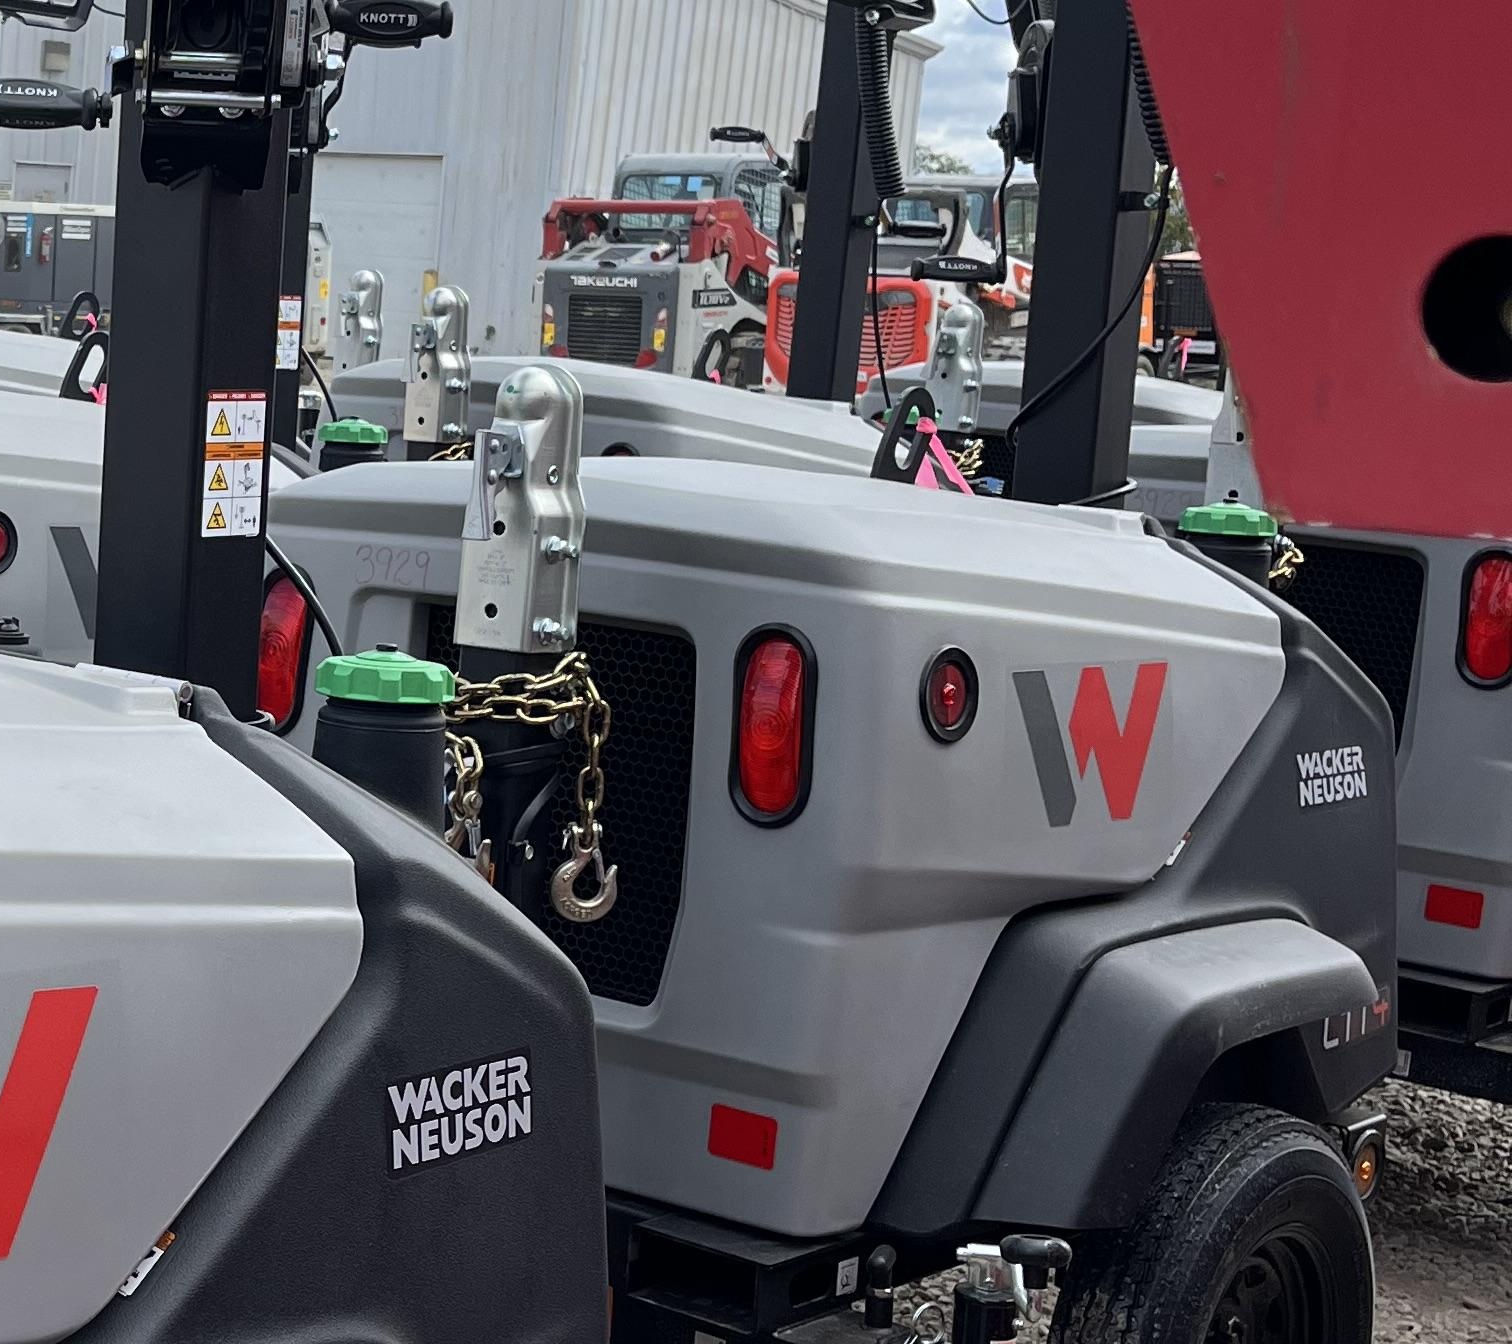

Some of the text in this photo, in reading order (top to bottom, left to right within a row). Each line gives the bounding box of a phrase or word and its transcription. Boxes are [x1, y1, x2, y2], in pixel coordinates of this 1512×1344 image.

[360, 12, 406, 24] KNOTT
[4, 86, 58, 97] KNOTT
[569, 275, 638, 289] TAKEUCHI
[355, 544, 431, 590] 3929
[1296, 745, 1366, 780] WACKER
[1299, 771, 1368, 808] NEUSON
[387, 1055, 532, 1124] WACKER
[392, 1095, 532, 1170] NEUSON
